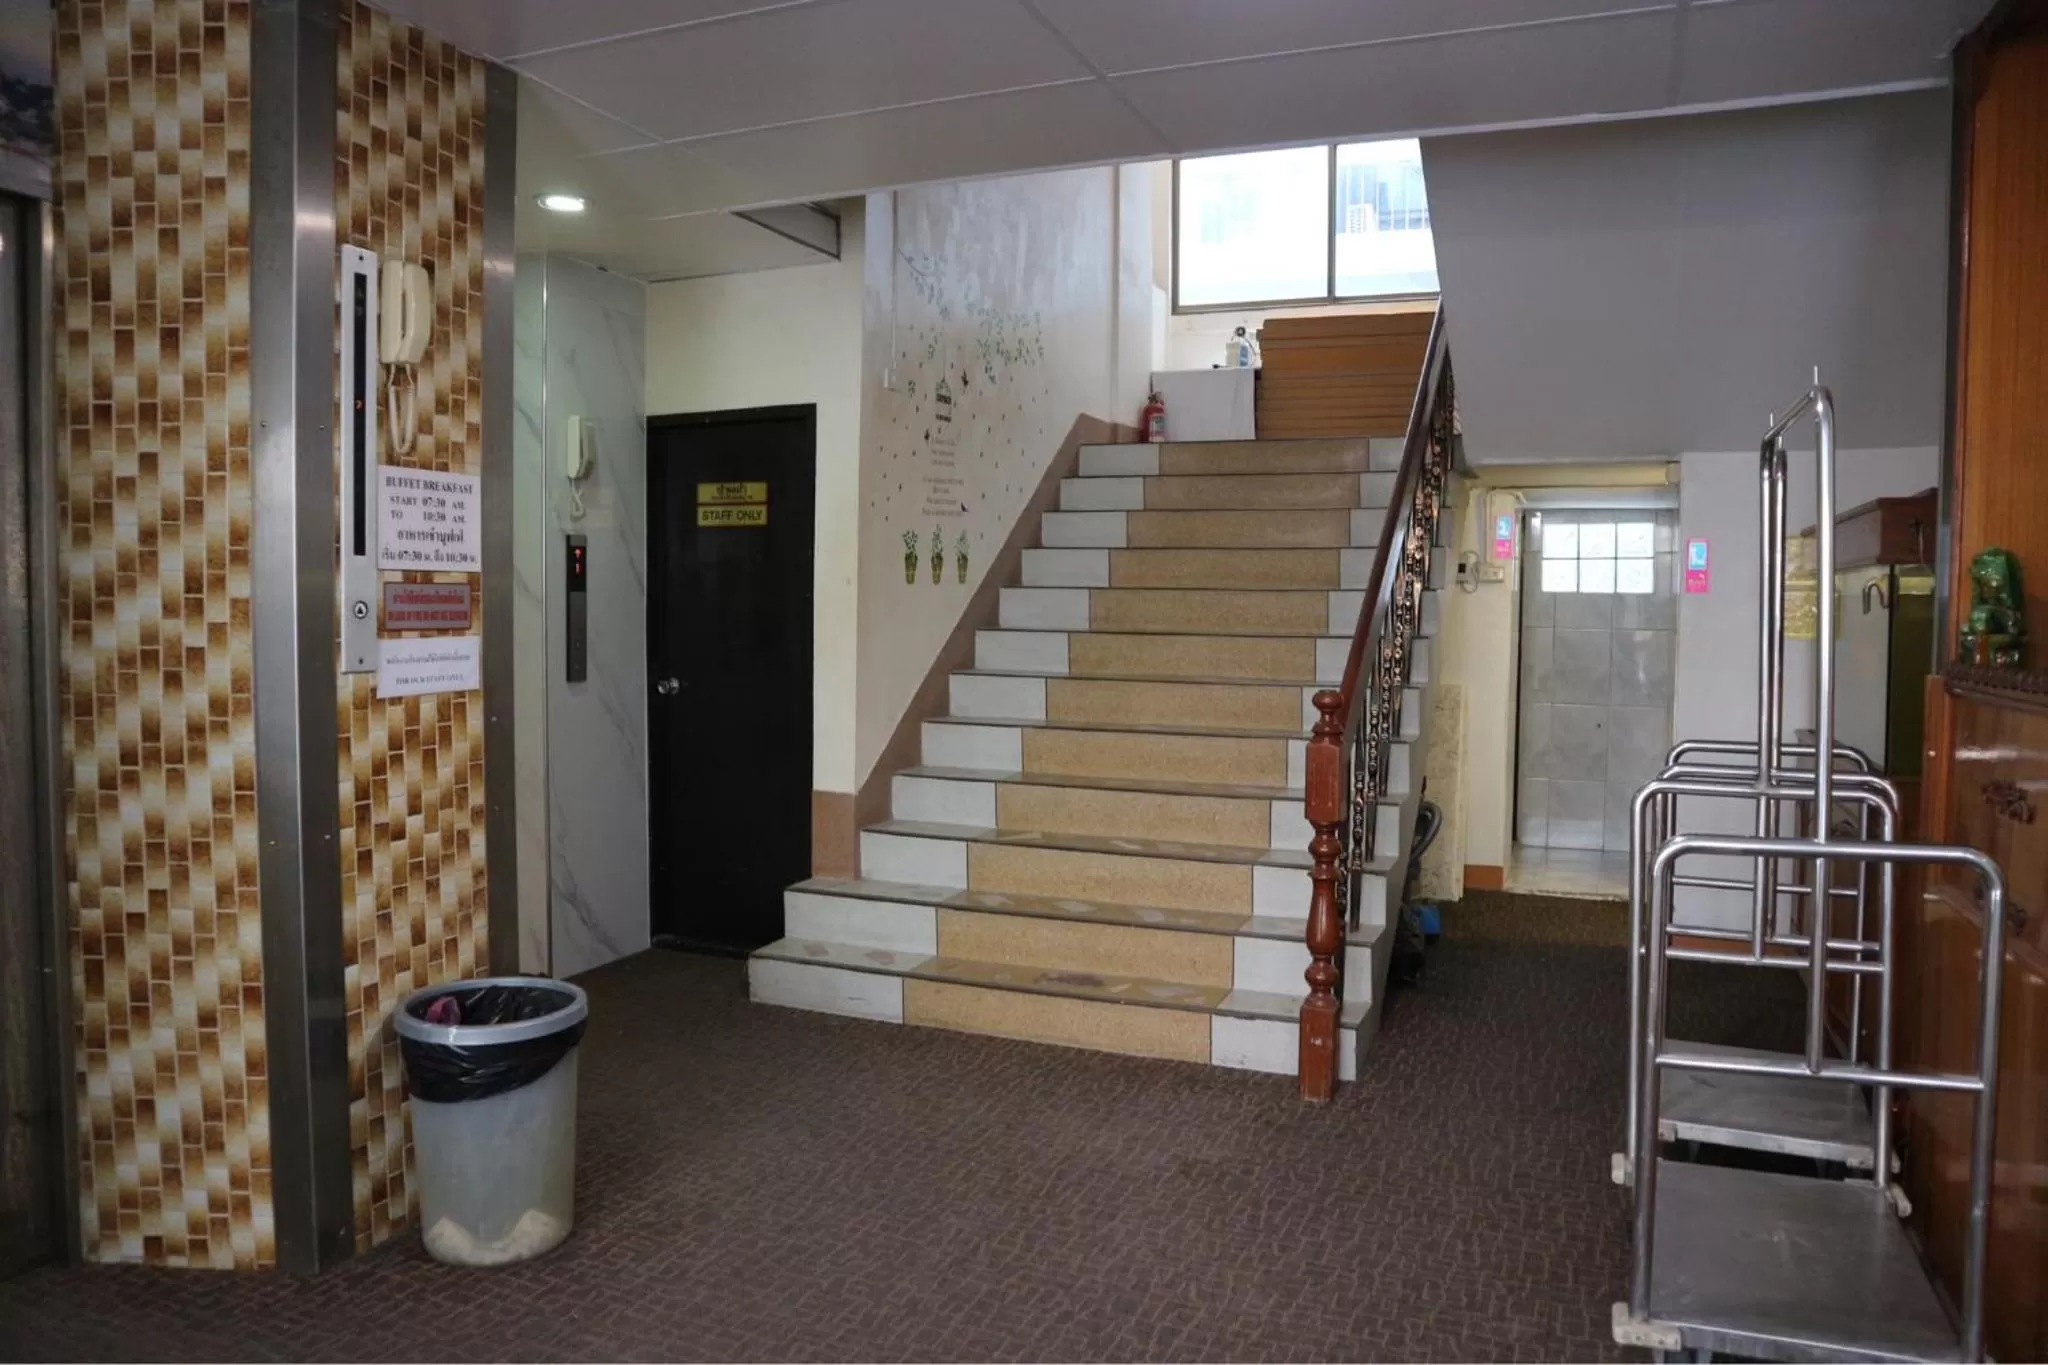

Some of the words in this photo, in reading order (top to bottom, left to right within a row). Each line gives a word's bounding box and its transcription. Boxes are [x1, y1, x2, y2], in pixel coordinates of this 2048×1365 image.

[385, 476, 420, 489] BUFFET
[422, 479, 473, 495] BREAKFAST
[389, 496, 417, 506] START
[422, 497, 446, 508] 07:30
[390, 509, 404, 520] TO
[423, 511, 446, 522] 10:30
[702, 510, 733, 521] STAFF
[736, 509, 762, 522] ONLY
[397, 550, 423, 561] 07:30
[446, 552, 468, 562] 10:30
